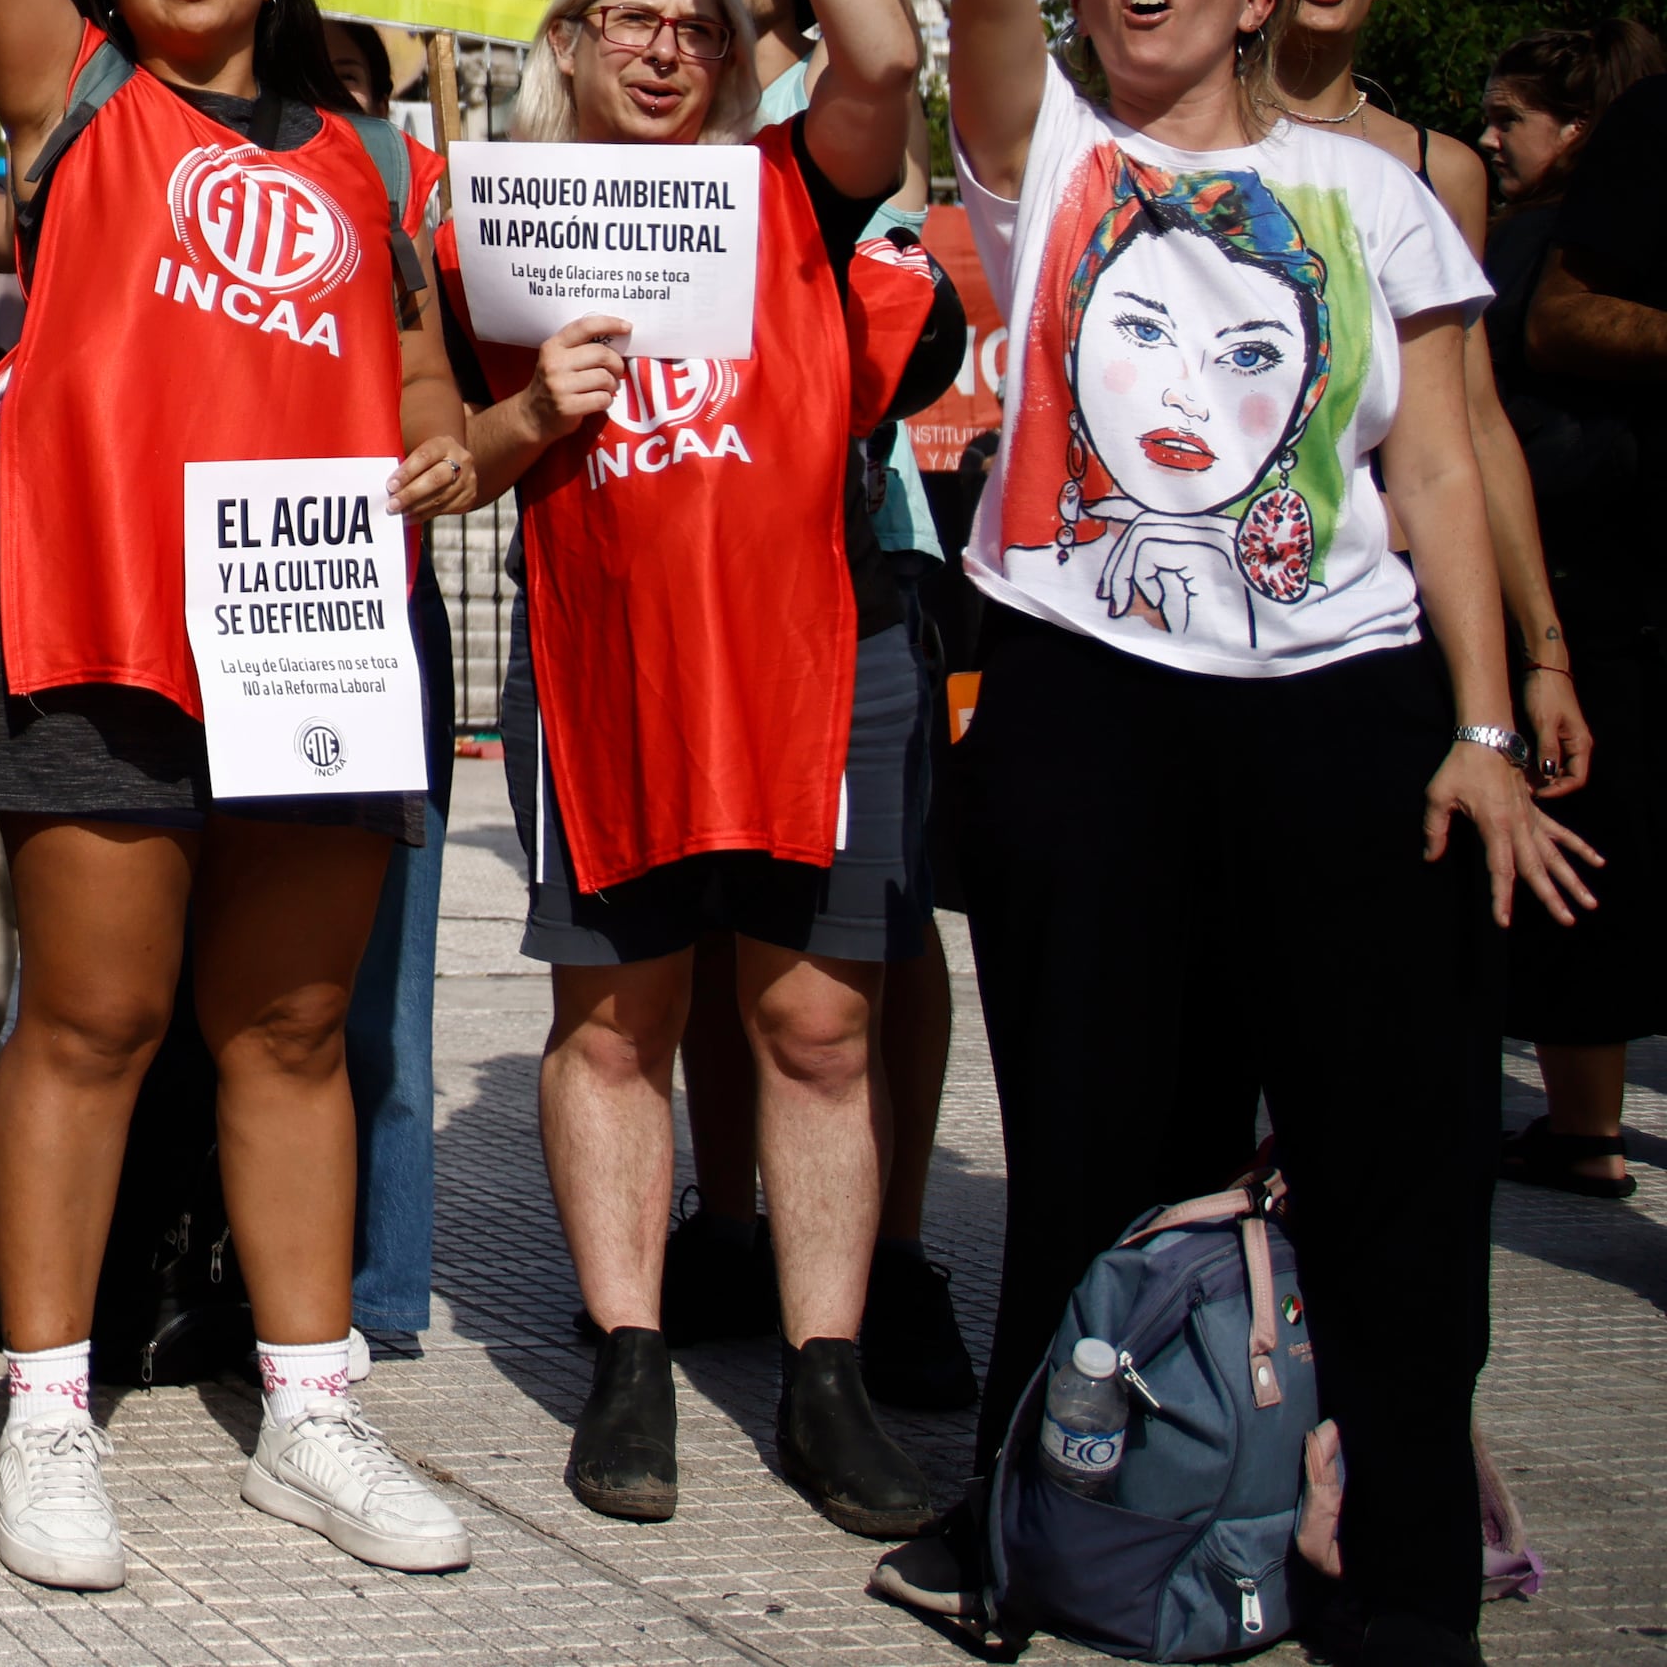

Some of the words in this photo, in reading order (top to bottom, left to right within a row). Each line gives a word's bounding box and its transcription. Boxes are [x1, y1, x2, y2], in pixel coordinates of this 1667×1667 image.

[471, 176, 493, 204] NI
[499, 177, 587, 209] SAQUEO
[592, 180, 736, 210] AMBIENTAL
[480, 219, 501, 246] NI
[507, 215, 598, 249] APAGÓN
[605, 222, 727, 253] CULTURAL
[512, 263, 524, 277] La
[527, 264, 546, 282] Ley
[549, 265, 563, 279] de
[566, 265, 623, 282] Glaciares
[627, 270, 642, 282] no
[645, 270, 659, 282] se
[662, 268, 690, 283] toca
[154, 257, 340, 358] INCAA
[529, 282, 543, 297] No
[545, 286, 553, 297] a
[554, 282, 565, 297] la
[568, 283, 620, 299] reforma
[623, 285, 670, 301] Laboral
[586, 424, 752, 490] INCAA
[217, 498, 261, 549] EL
[271, 495, 374, 547] AGUA
[219, 563, 233, 593] Y
[240, 562, 269, 593] LA
[275, 558, 379, 592] CULTURA
[215, 604, 244, 635] SE
[249, 599, 385, 634] DEFIENDEN
[221, 659, 236, 674] La
[238, 659, 261, 677] Ley
[262, 658, 277, 673] de
[278, 657, 336, 673] Glaciares
[338, 660, 353, 671] no
[356, 660, 369, 671] se
[371, 656, 398, 670] toca
[243, 682, 260, 696] NO
[263, 685, 270, 696] a
[271, 681, 284, 695] la
[286, 679, 338, 695] Reforma
[341, 677, 386, 693] Laboral
[314, 758, 347, 777] INCAA
